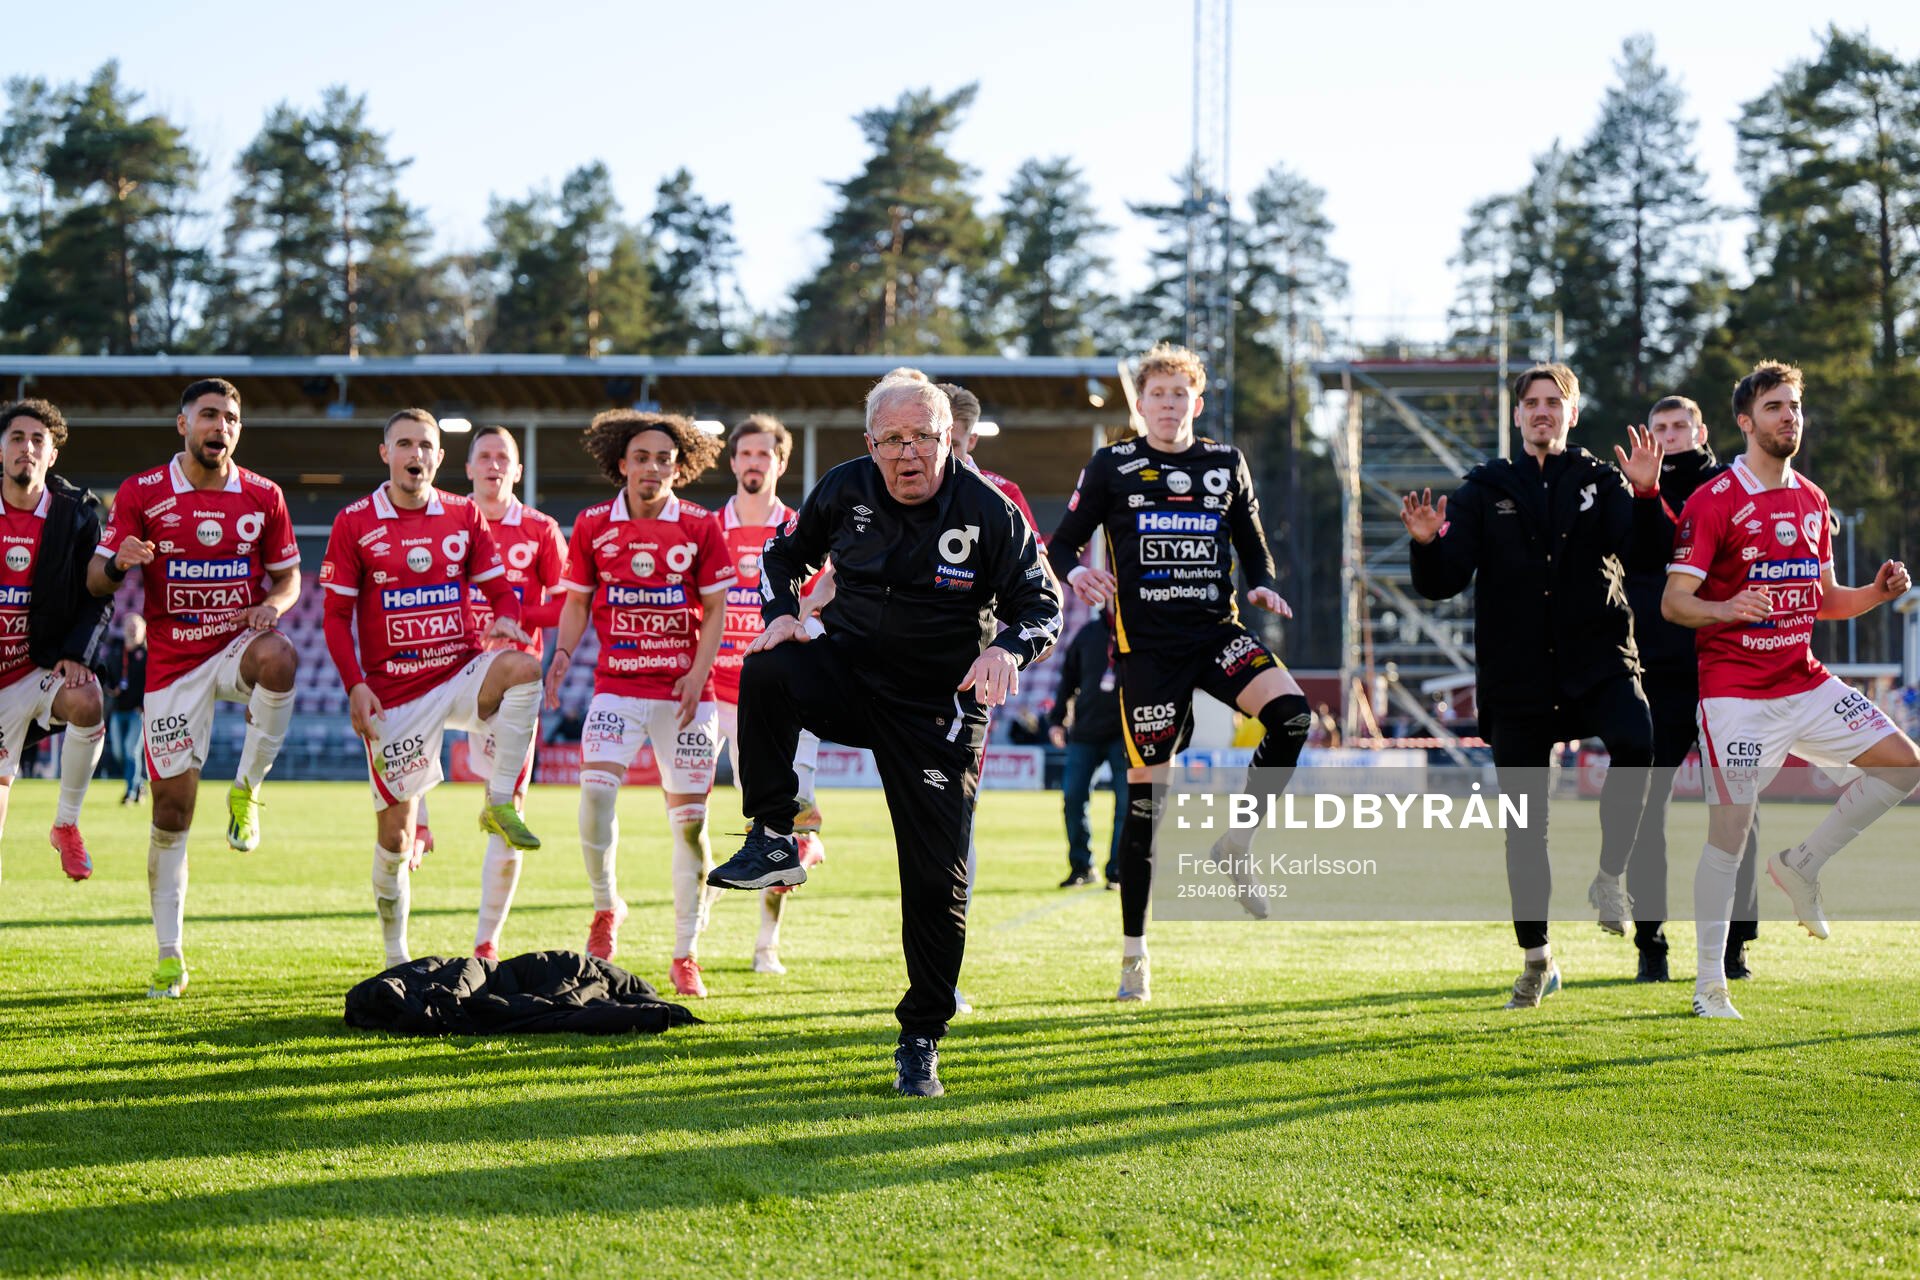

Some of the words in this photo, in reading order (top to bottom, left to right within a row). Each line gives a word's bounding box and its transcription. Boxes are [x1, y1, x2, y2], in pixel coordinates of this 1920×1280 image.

[138, 471, 163, 485] AVIS
[193, 510, 225, 519] Helmia
[586, 505, 610, 517] AVIS
[1139, 513, 1218, 531] Helmia
[169, 559, 248, 578] Helmia
[937, 564, 974, 579] Helmia
[1174, 568, 1221, 579] Munkfors
[1749, 559, 1818, 579] Helmia
[384, 585, 459, 608] Helmia
[609, 586, 684, 605] Helmia
[1140, 585, 1207, 601] ByggDialog
[641, 638, 690, 650] Munkfors
[1743, 631, 1811, 650] ByggDialog
[609, 654, 677, 671] ByggDialog
[1133, 702, 1176, 722] CEOS
[1834, 692, 1863, 714] CEO
[1842, 702, 1870, 722] FRITZ
[151, 713, 187, 733] CEOS
[590, 710, 625, 729] CEOS
[383, 734, 424, 759] CEOS
[1143, 744, 1156, 757] 25
[1727, 742, 1762, 757] CEOS
[923, 778, 945, 790] umbro
